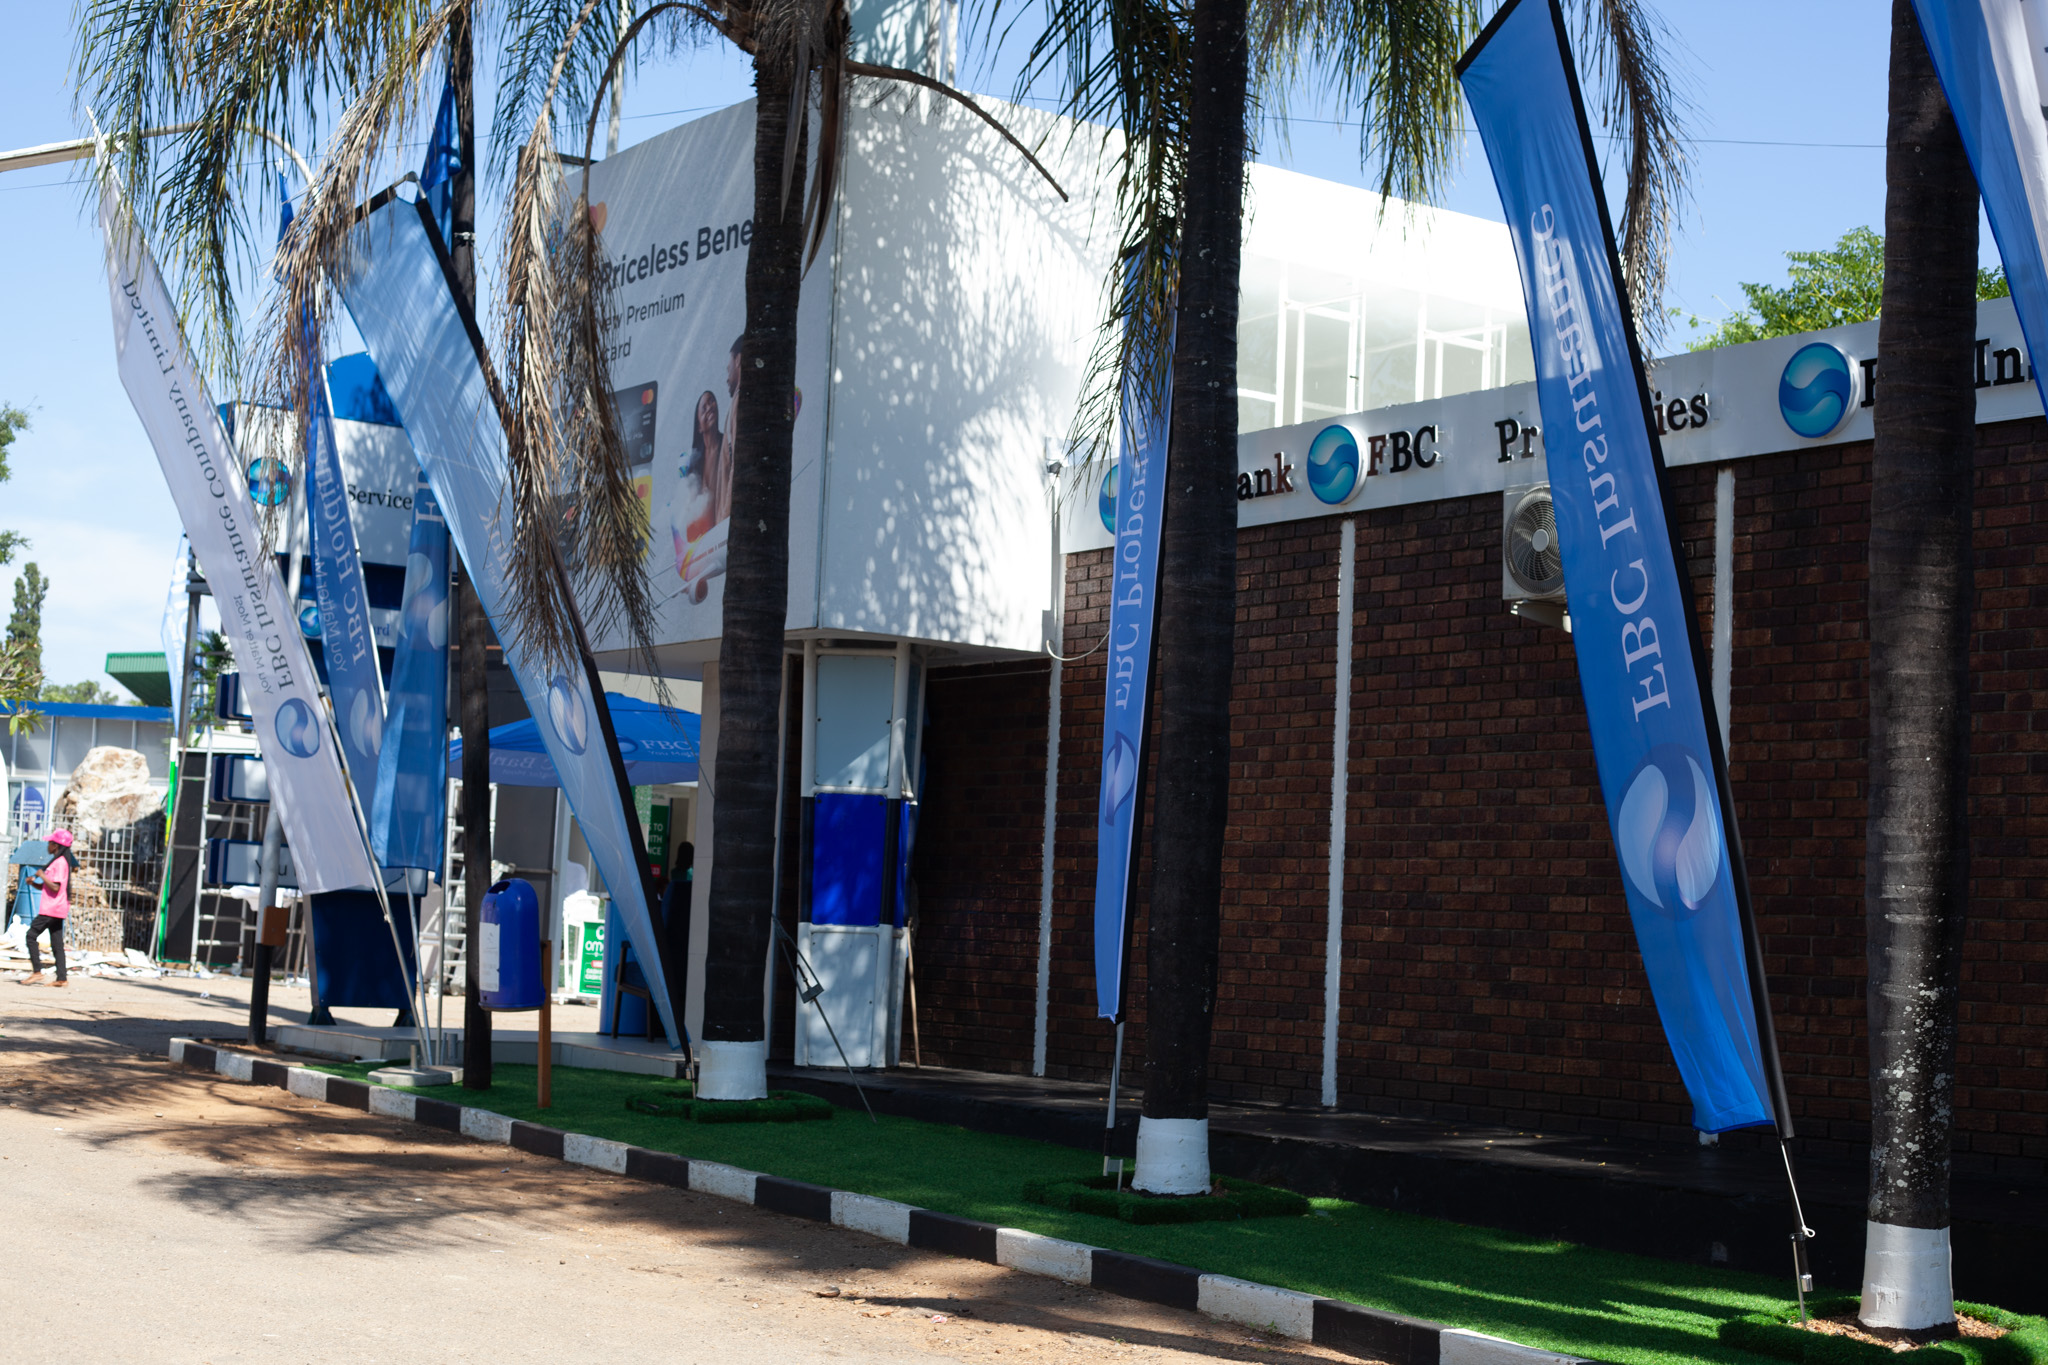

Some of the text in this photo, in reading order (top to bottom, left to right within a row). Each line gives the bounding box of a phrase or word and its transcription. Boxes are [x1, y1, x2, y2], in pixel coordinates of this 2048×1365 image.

[600, 219, 754, 290] Priceless Bene
[604, 292, 685, 332] ew Premium
[1367, 425, 1439, 476] FBC
[1237, 452, 1294, 500] ank
[255, 859, 288, 876] Yu
